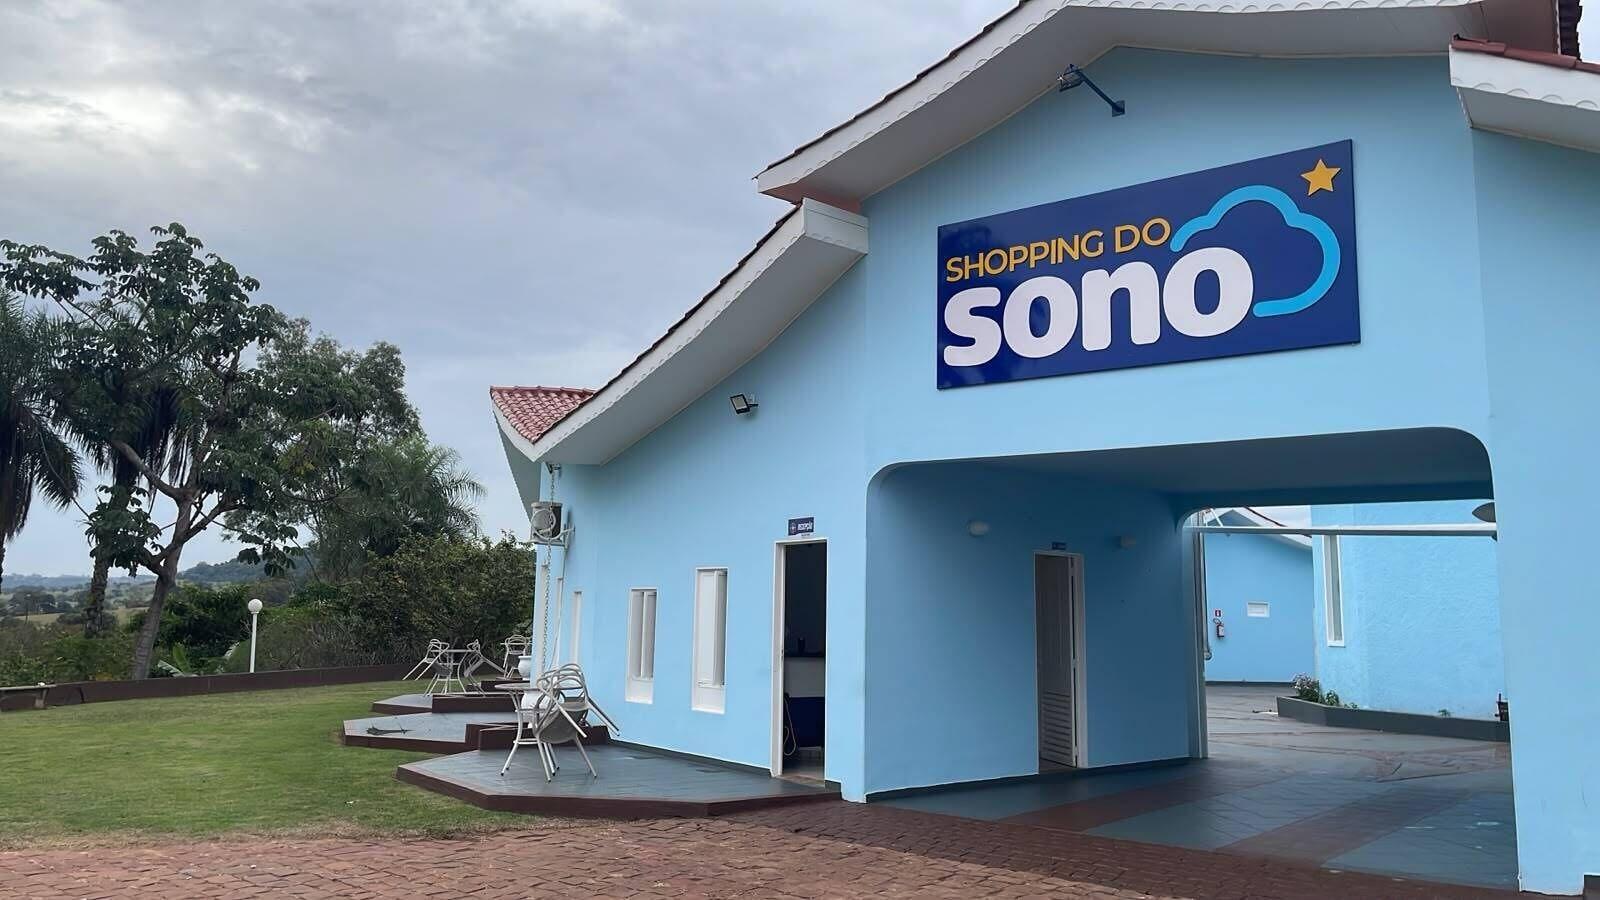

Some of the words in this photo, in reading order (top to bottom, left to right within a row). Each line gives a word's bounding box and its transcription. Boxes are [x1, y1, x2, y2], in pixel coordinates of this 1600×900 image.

[946, 230, 1104, 282] SHOPPING
[1115, 217, 1171, 253] DO
[944, 247, 1254, 367] sono
